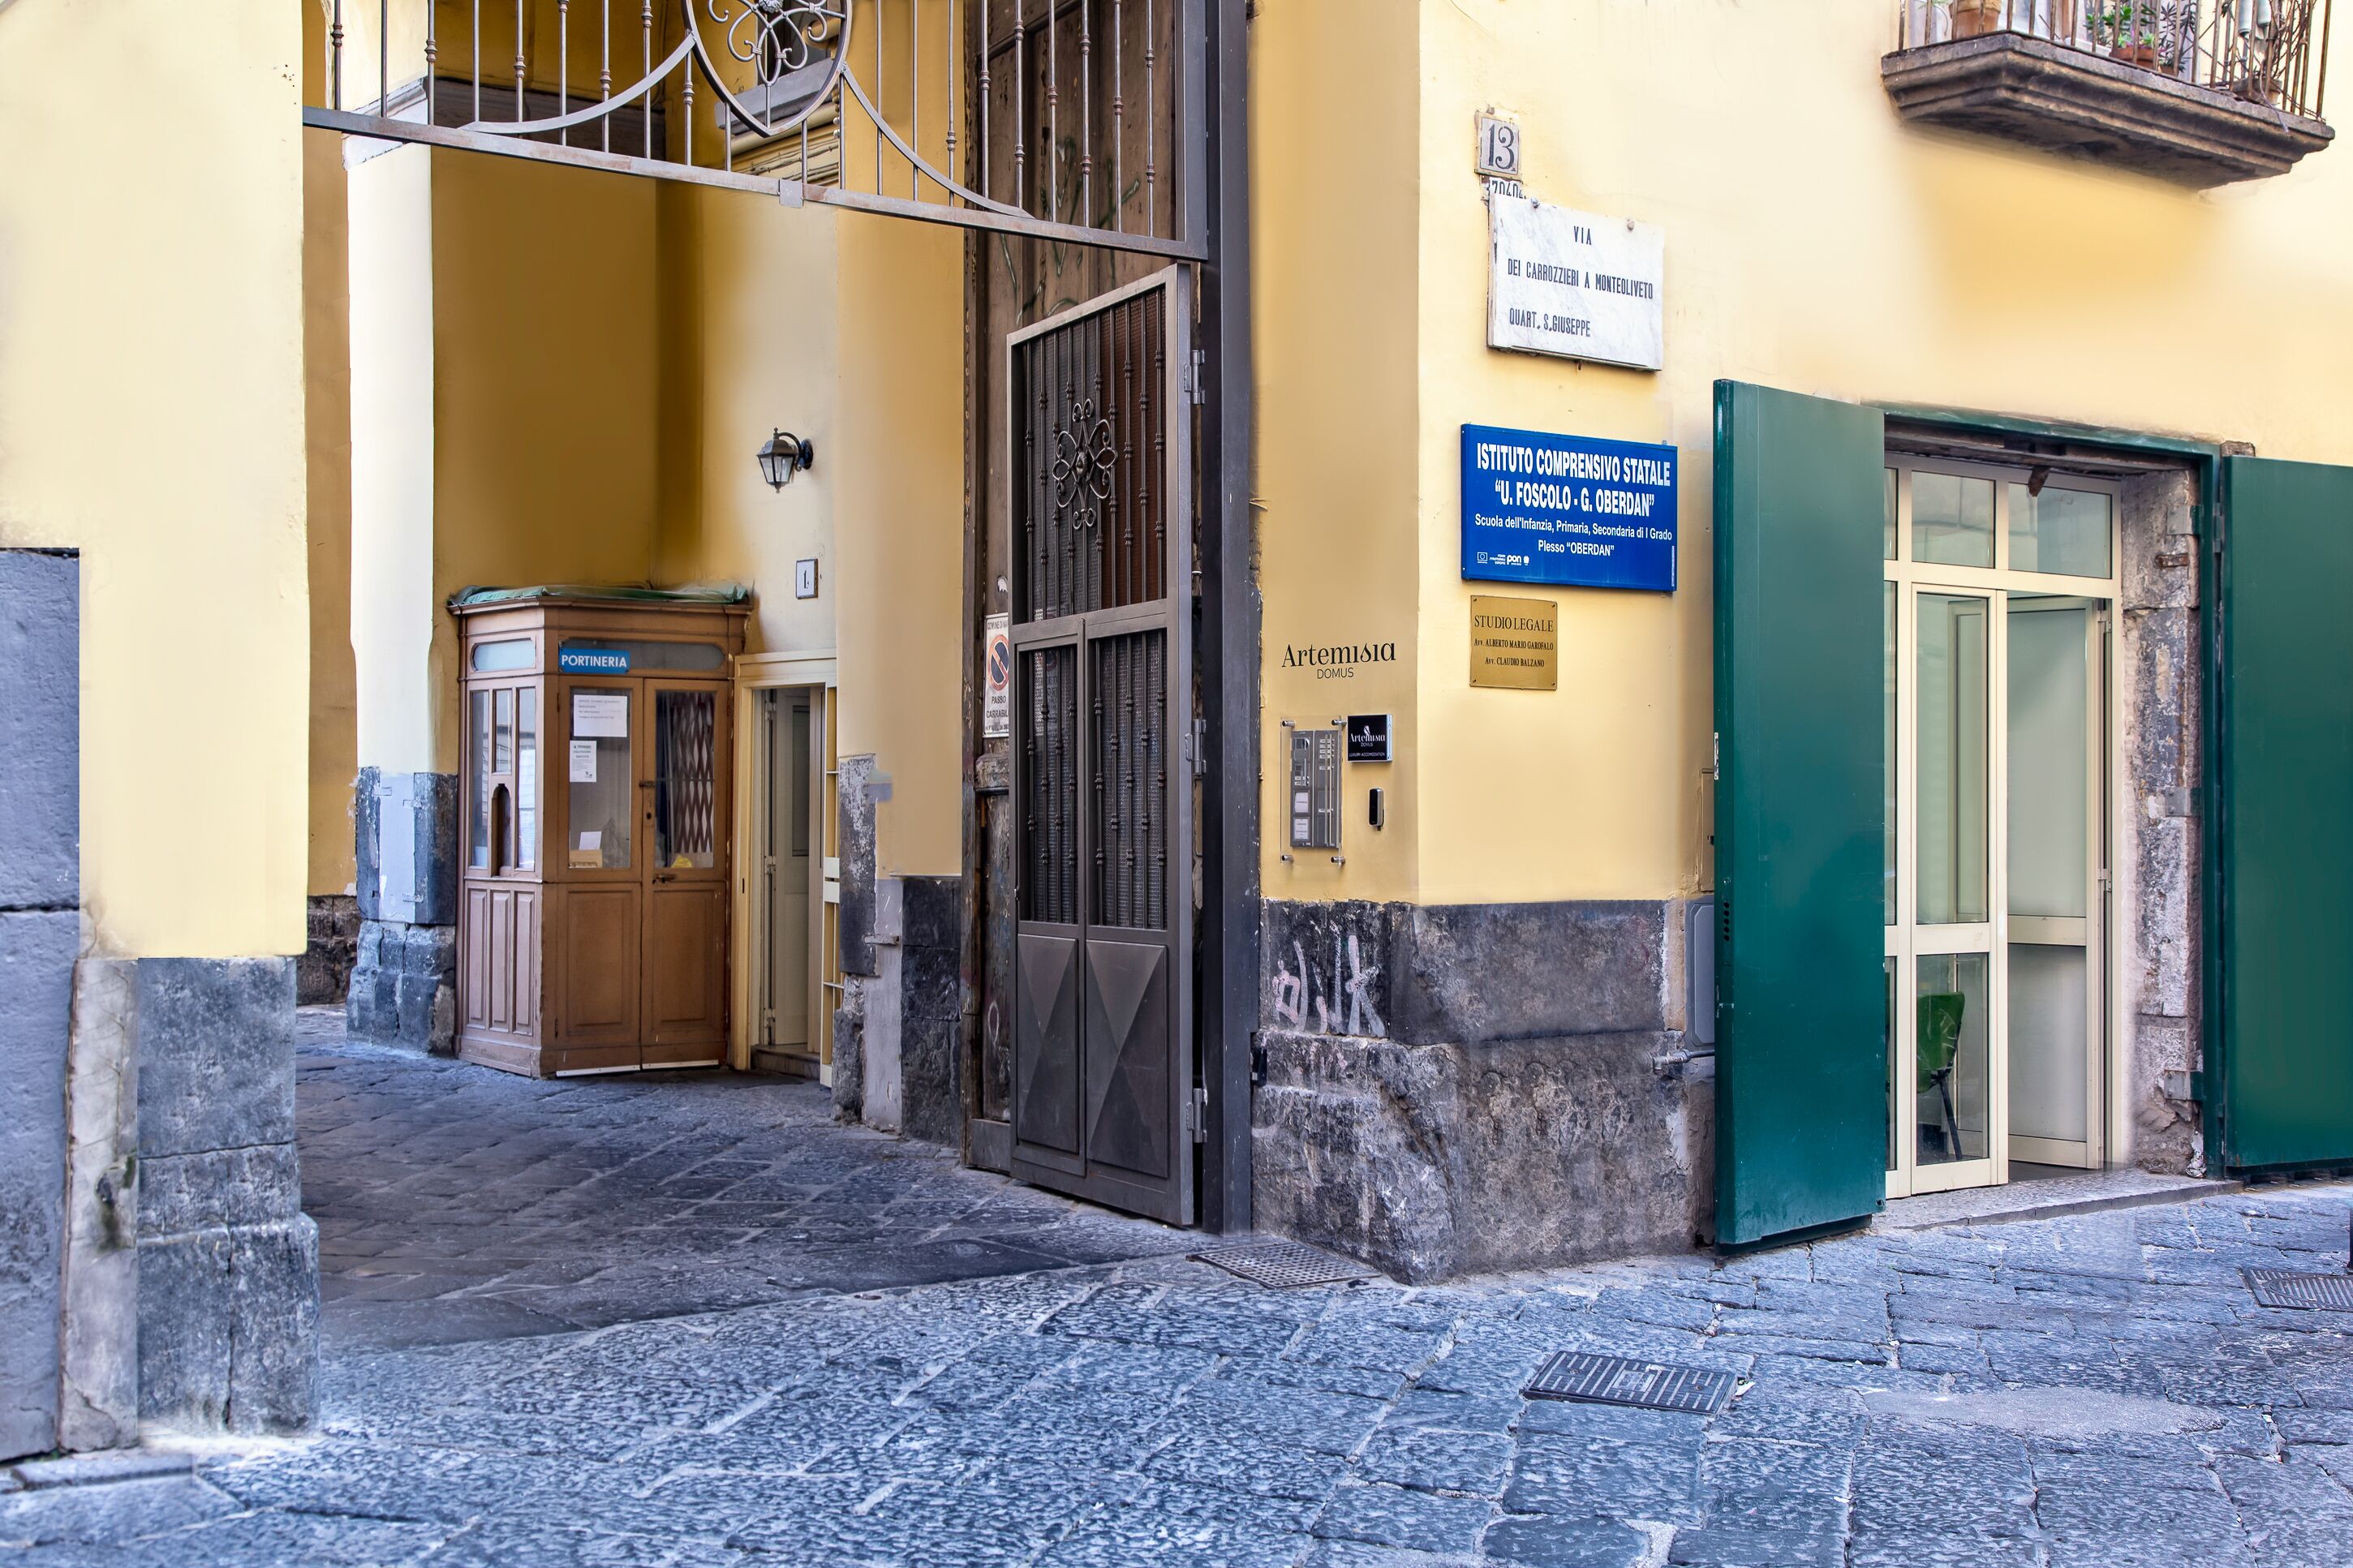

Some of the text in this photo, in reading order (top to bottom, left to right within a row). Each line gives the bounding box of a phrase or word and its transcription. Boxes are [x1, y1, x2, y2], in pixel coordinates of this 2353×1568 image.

[1487, 123, 1515, 170] 13
[1573, 226, 1592, 245] VIA
[1508, 258, 1654, 299] DEI CARROZZIERI A MONTEOLIVETO
[1509, 307, 1541, 330] QUART.
[1477, 442, 1671, 487] ISTITUTO COMPRENSIVO STATALE
[1516, 481, 1572, 511] FOSCOLO
[1581, 487, 1593, 512] G.
[1595, 488, 1655, 517] OBERDAN”
[1475, 513, 1672, 541] Scuola dell'Infanzia, Primaria, Secondaria di I Grado
[1538, 539, 1615, 556] Plesso “OBERDAN”
[1474, 615, 1554, 633] STUDIO LEGALE
[1485, 638, 1508, 648] ALBERTO
[1508, 639, 1527, 649] MARIO
[1527, 641, 1554, 651] GAROFALO
[561, 655, 627, 668] PORTINERIA
[1281, 642, 1396, 668] Artemisia
[1496, 656, 1520, 667] CLAUDIO
[1520, 658, 1545, 668] BALZANO
[1317, 667, 1354, 680] DOMUS
[991, 695, 1007, 704] PASSO
[986, 709, 1009, 719] CARRABIL
[1349, 732, 1386, 743] Artemisia
